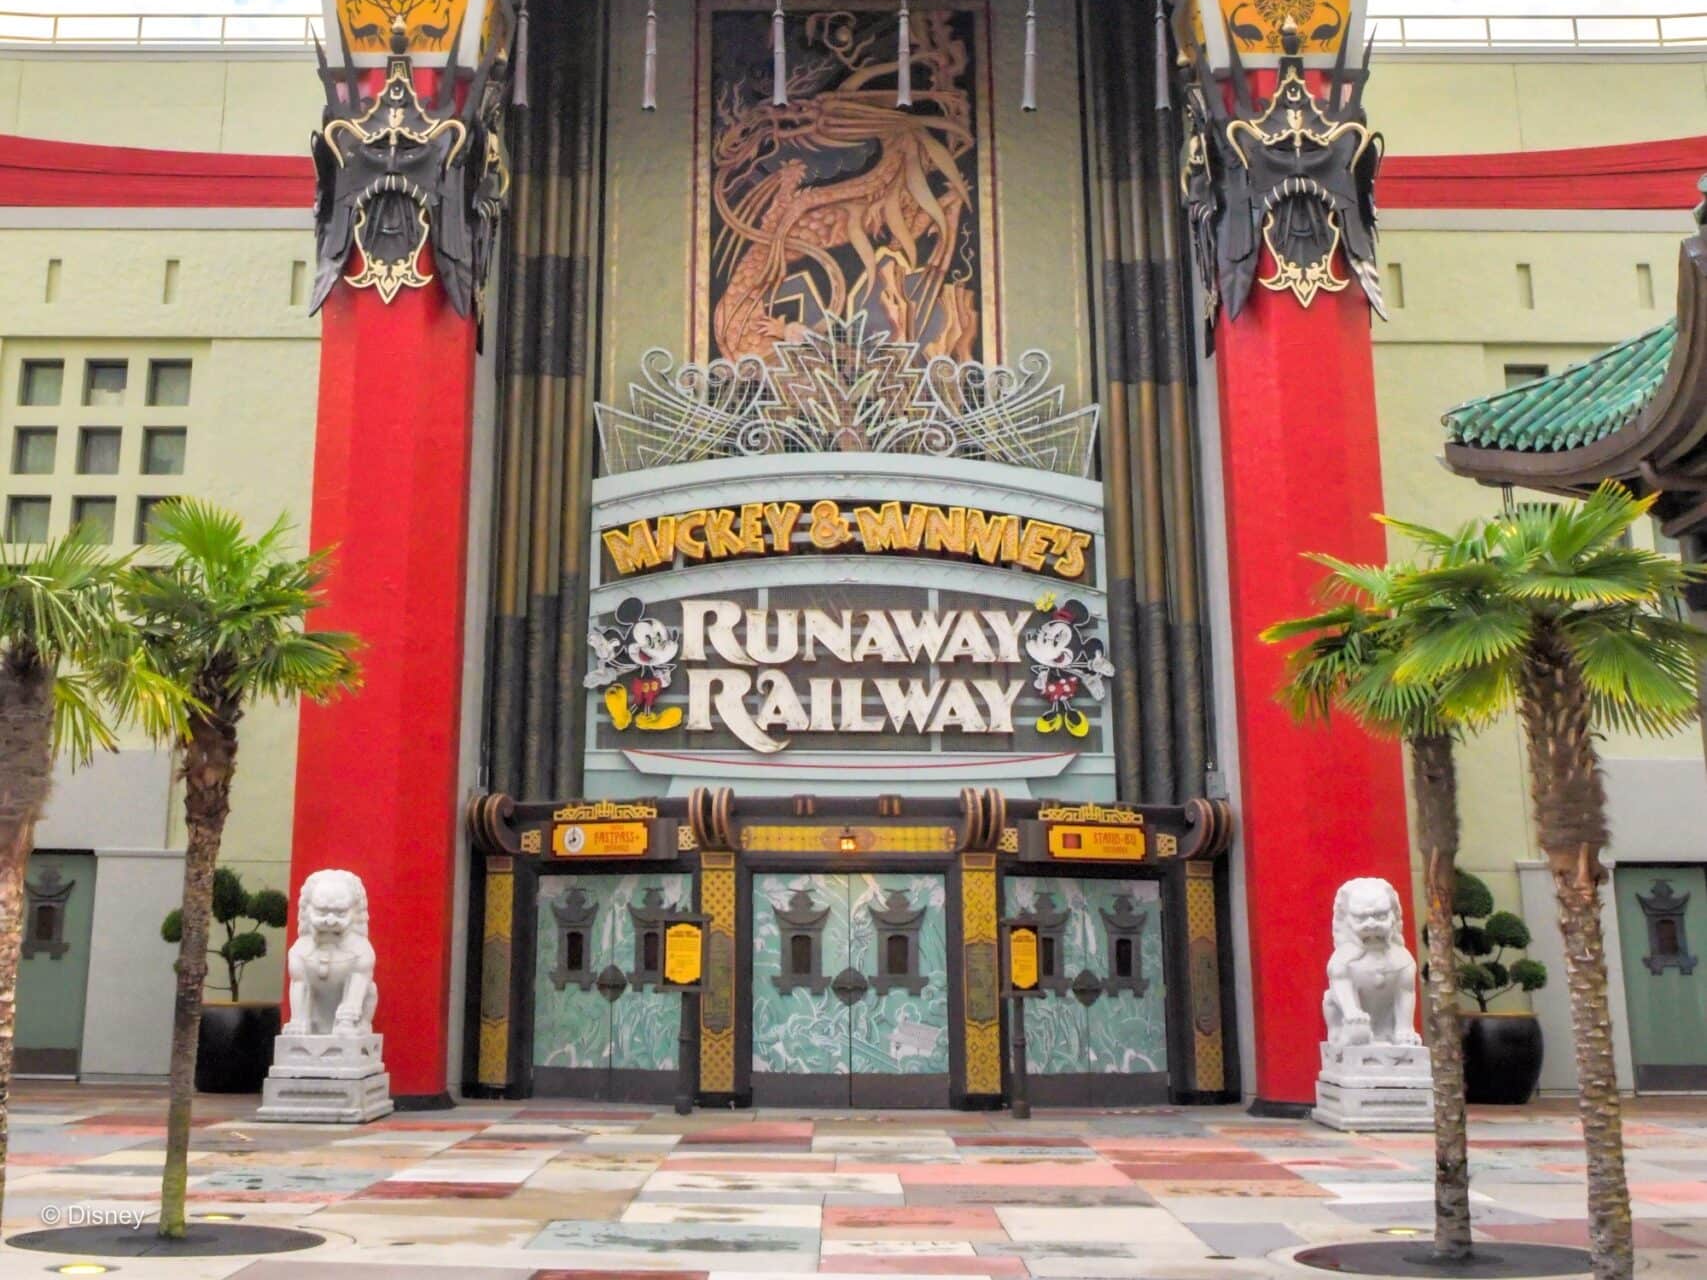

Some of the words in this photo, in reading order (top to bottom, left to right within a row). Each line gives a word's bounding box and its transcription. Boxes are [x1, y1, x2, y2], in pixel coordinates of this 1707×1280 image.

[601, 502, 800, 575] MICKEY
[809, 500, 853, 549] &
[853, 502, 1092, 577] MINNIE'S
[679, 599, 1033, 666] RUNAWAY
[684, 668, 1027, 754] RAILWAY
